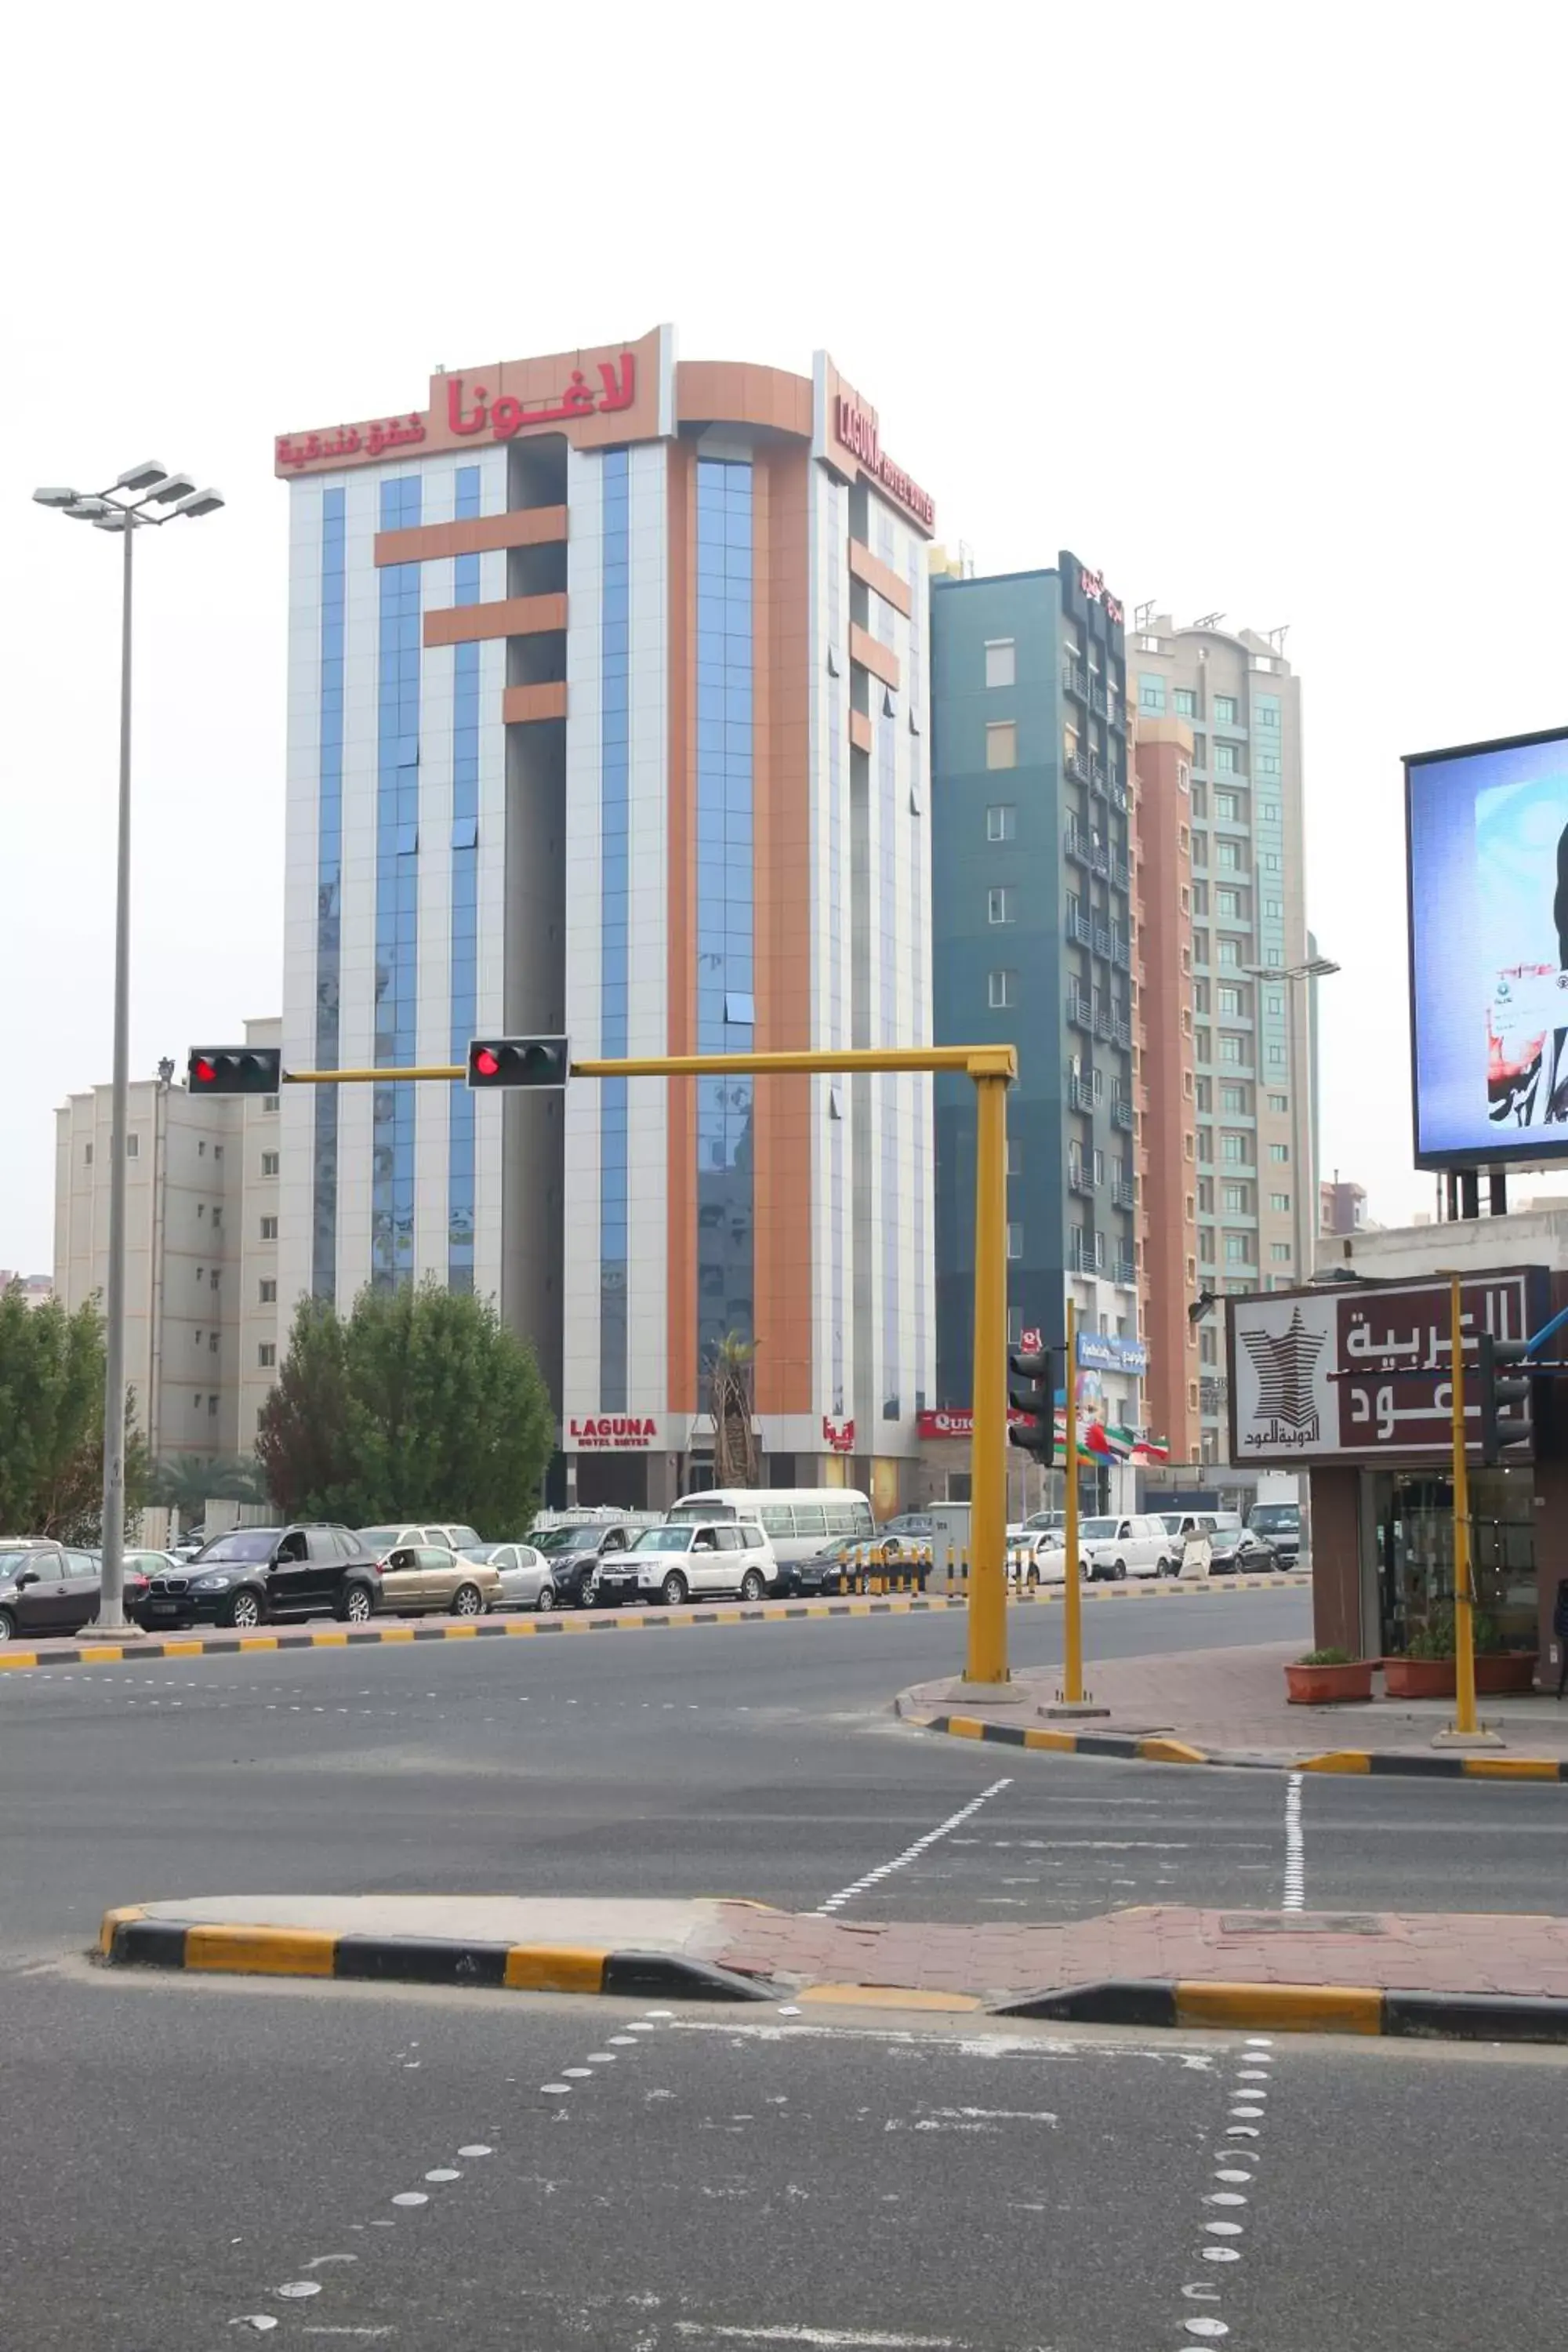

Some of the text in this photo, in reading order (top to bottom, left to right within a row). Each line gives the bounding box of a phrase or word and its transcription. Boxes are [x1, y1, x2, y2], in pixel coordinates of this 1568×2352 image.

[446, 352, 636, 441] لاغونا
[277, 411, 426, 469] شقق فندقية
[1346, 1290, 1508, 1370] العربية
[570, 1418, 657, 1437] LAGUNA
[578, 1438, 650, 1446] HOTEL SUITES
[1243, 1414, 1320, 1449] الدولية للعود
